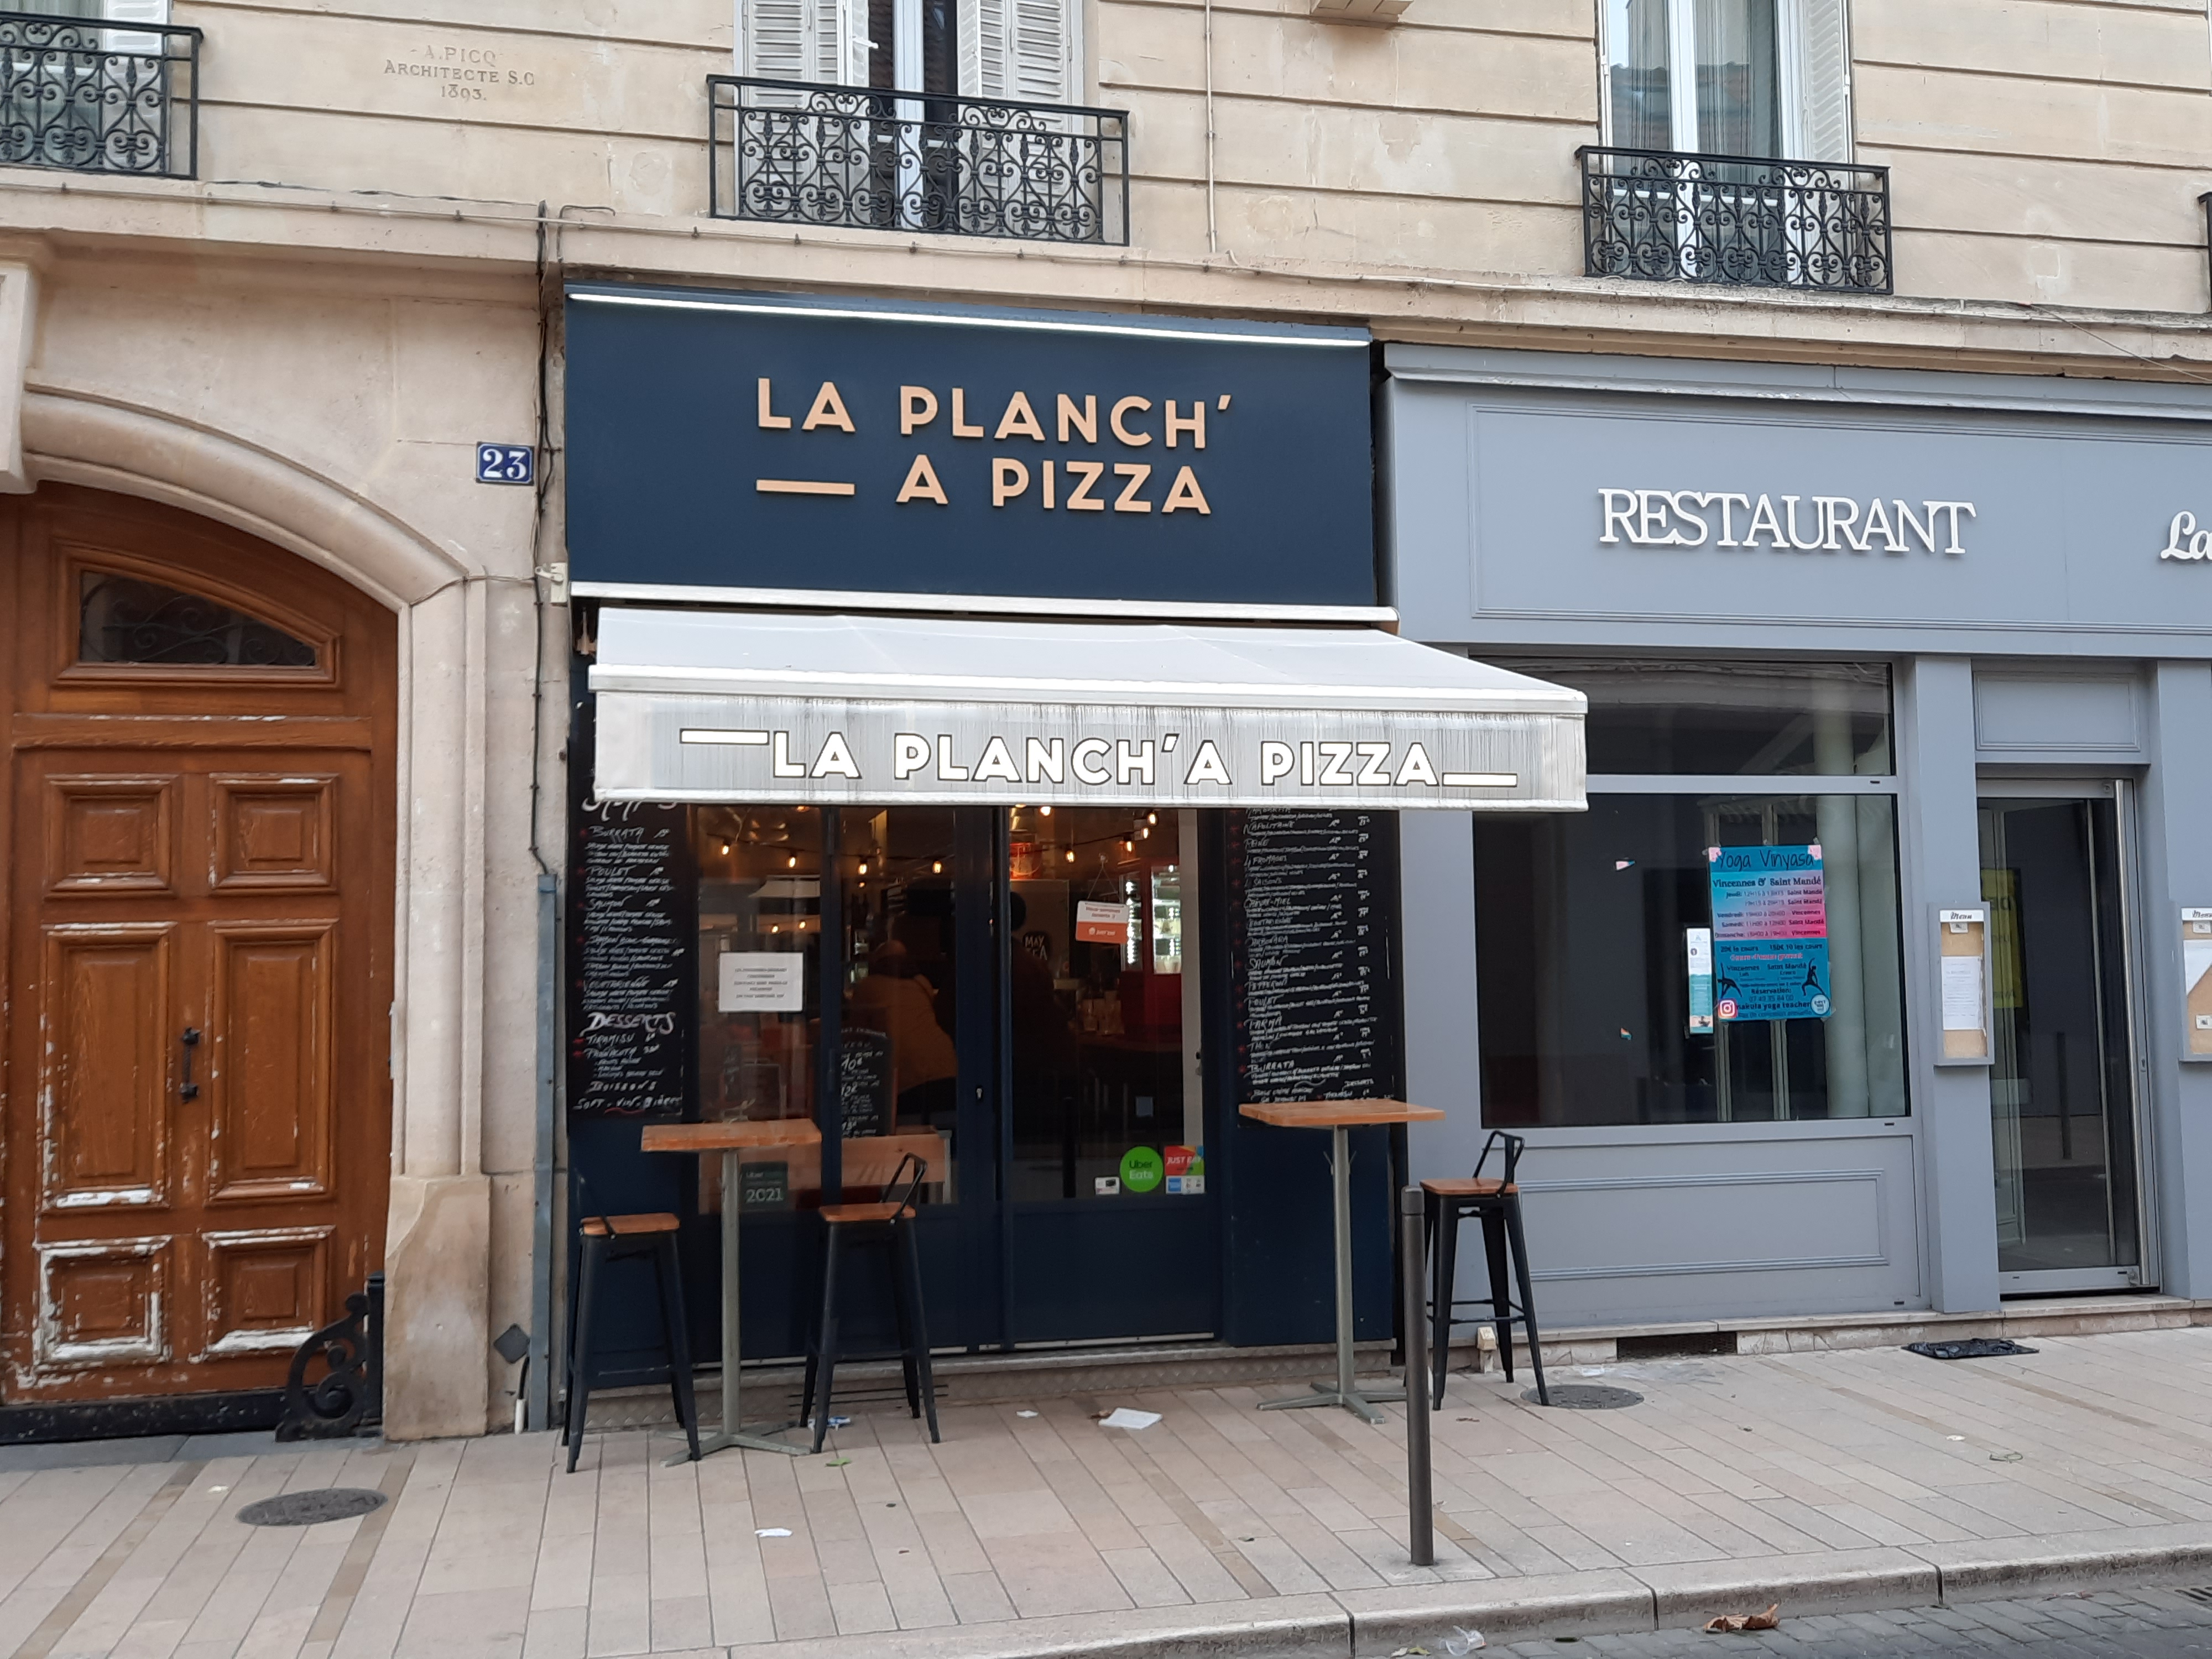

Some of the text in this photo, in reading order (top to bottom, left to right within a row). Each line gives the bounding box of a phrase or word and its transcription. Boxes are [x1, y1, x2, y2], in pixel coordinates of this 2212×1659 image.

[384, 59, 499, 83] ARCHITECTE
[758, 378, 1231, 449] LA PLANCH'
[483, 448, 526, 479] 23
[896, 455, 1211, 514] A PIZZA
[1598, 488, 1976, 554] RESTAURANT
[773, 730, 863, 779] LA
[1260, 741, 1439, 786] PIZZA
[1720, 849, 1814, 872] Yoga Vinyasa
[1713, 879, 1756, 888] Vincennes
[1770, 877, 1791, 885] Saint
[1793, 875, 1822, 885] Mandé
[1129, 1161, 1153, 1169] Uber
[1167, 1156, 1186, 1165] JUST
[1129, 1170, 1154, 1180] Eats
[746, 1188, 784, 1203] 2021
